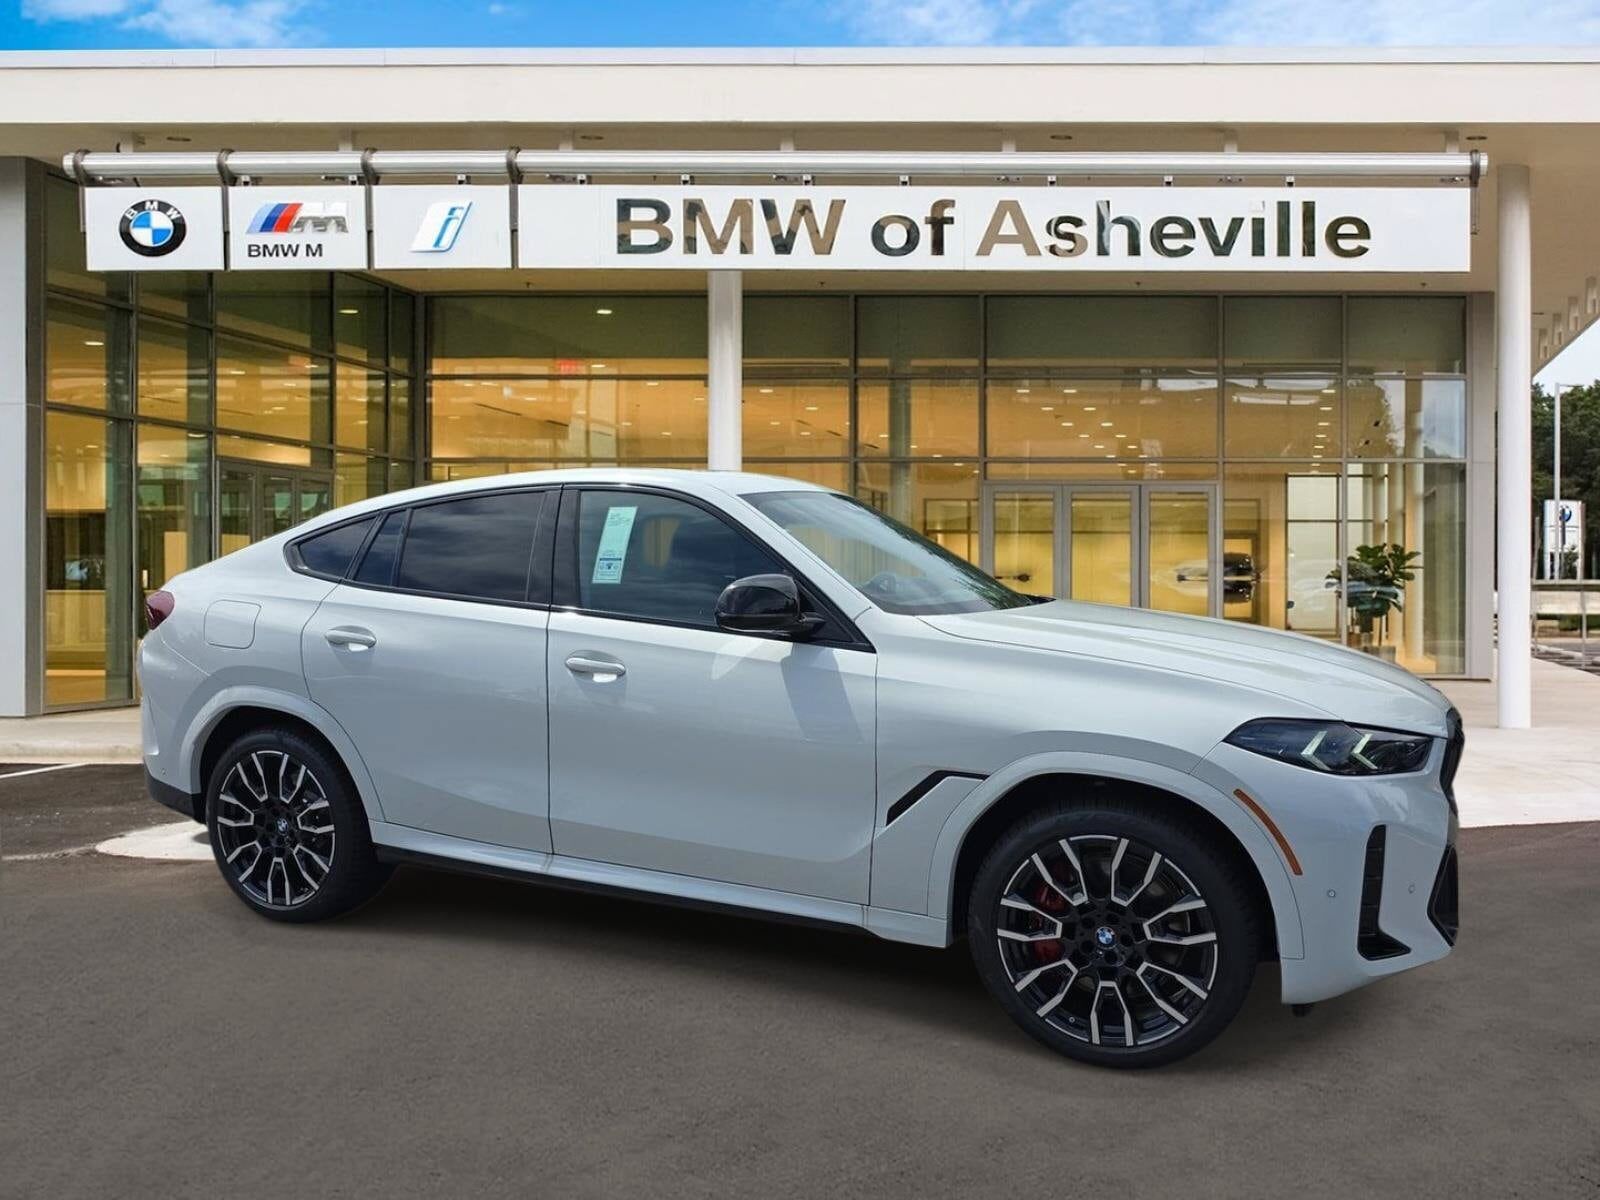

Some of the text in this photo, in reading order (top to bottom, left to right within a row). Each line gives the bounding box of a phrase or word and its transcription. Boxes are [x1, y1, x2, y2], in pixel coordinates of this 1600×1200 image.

[124, 200, 181, 220] BMW
[616, 198, 1371, 258] BMW of Asheville
[247, 243, 323, 257] BMW M
